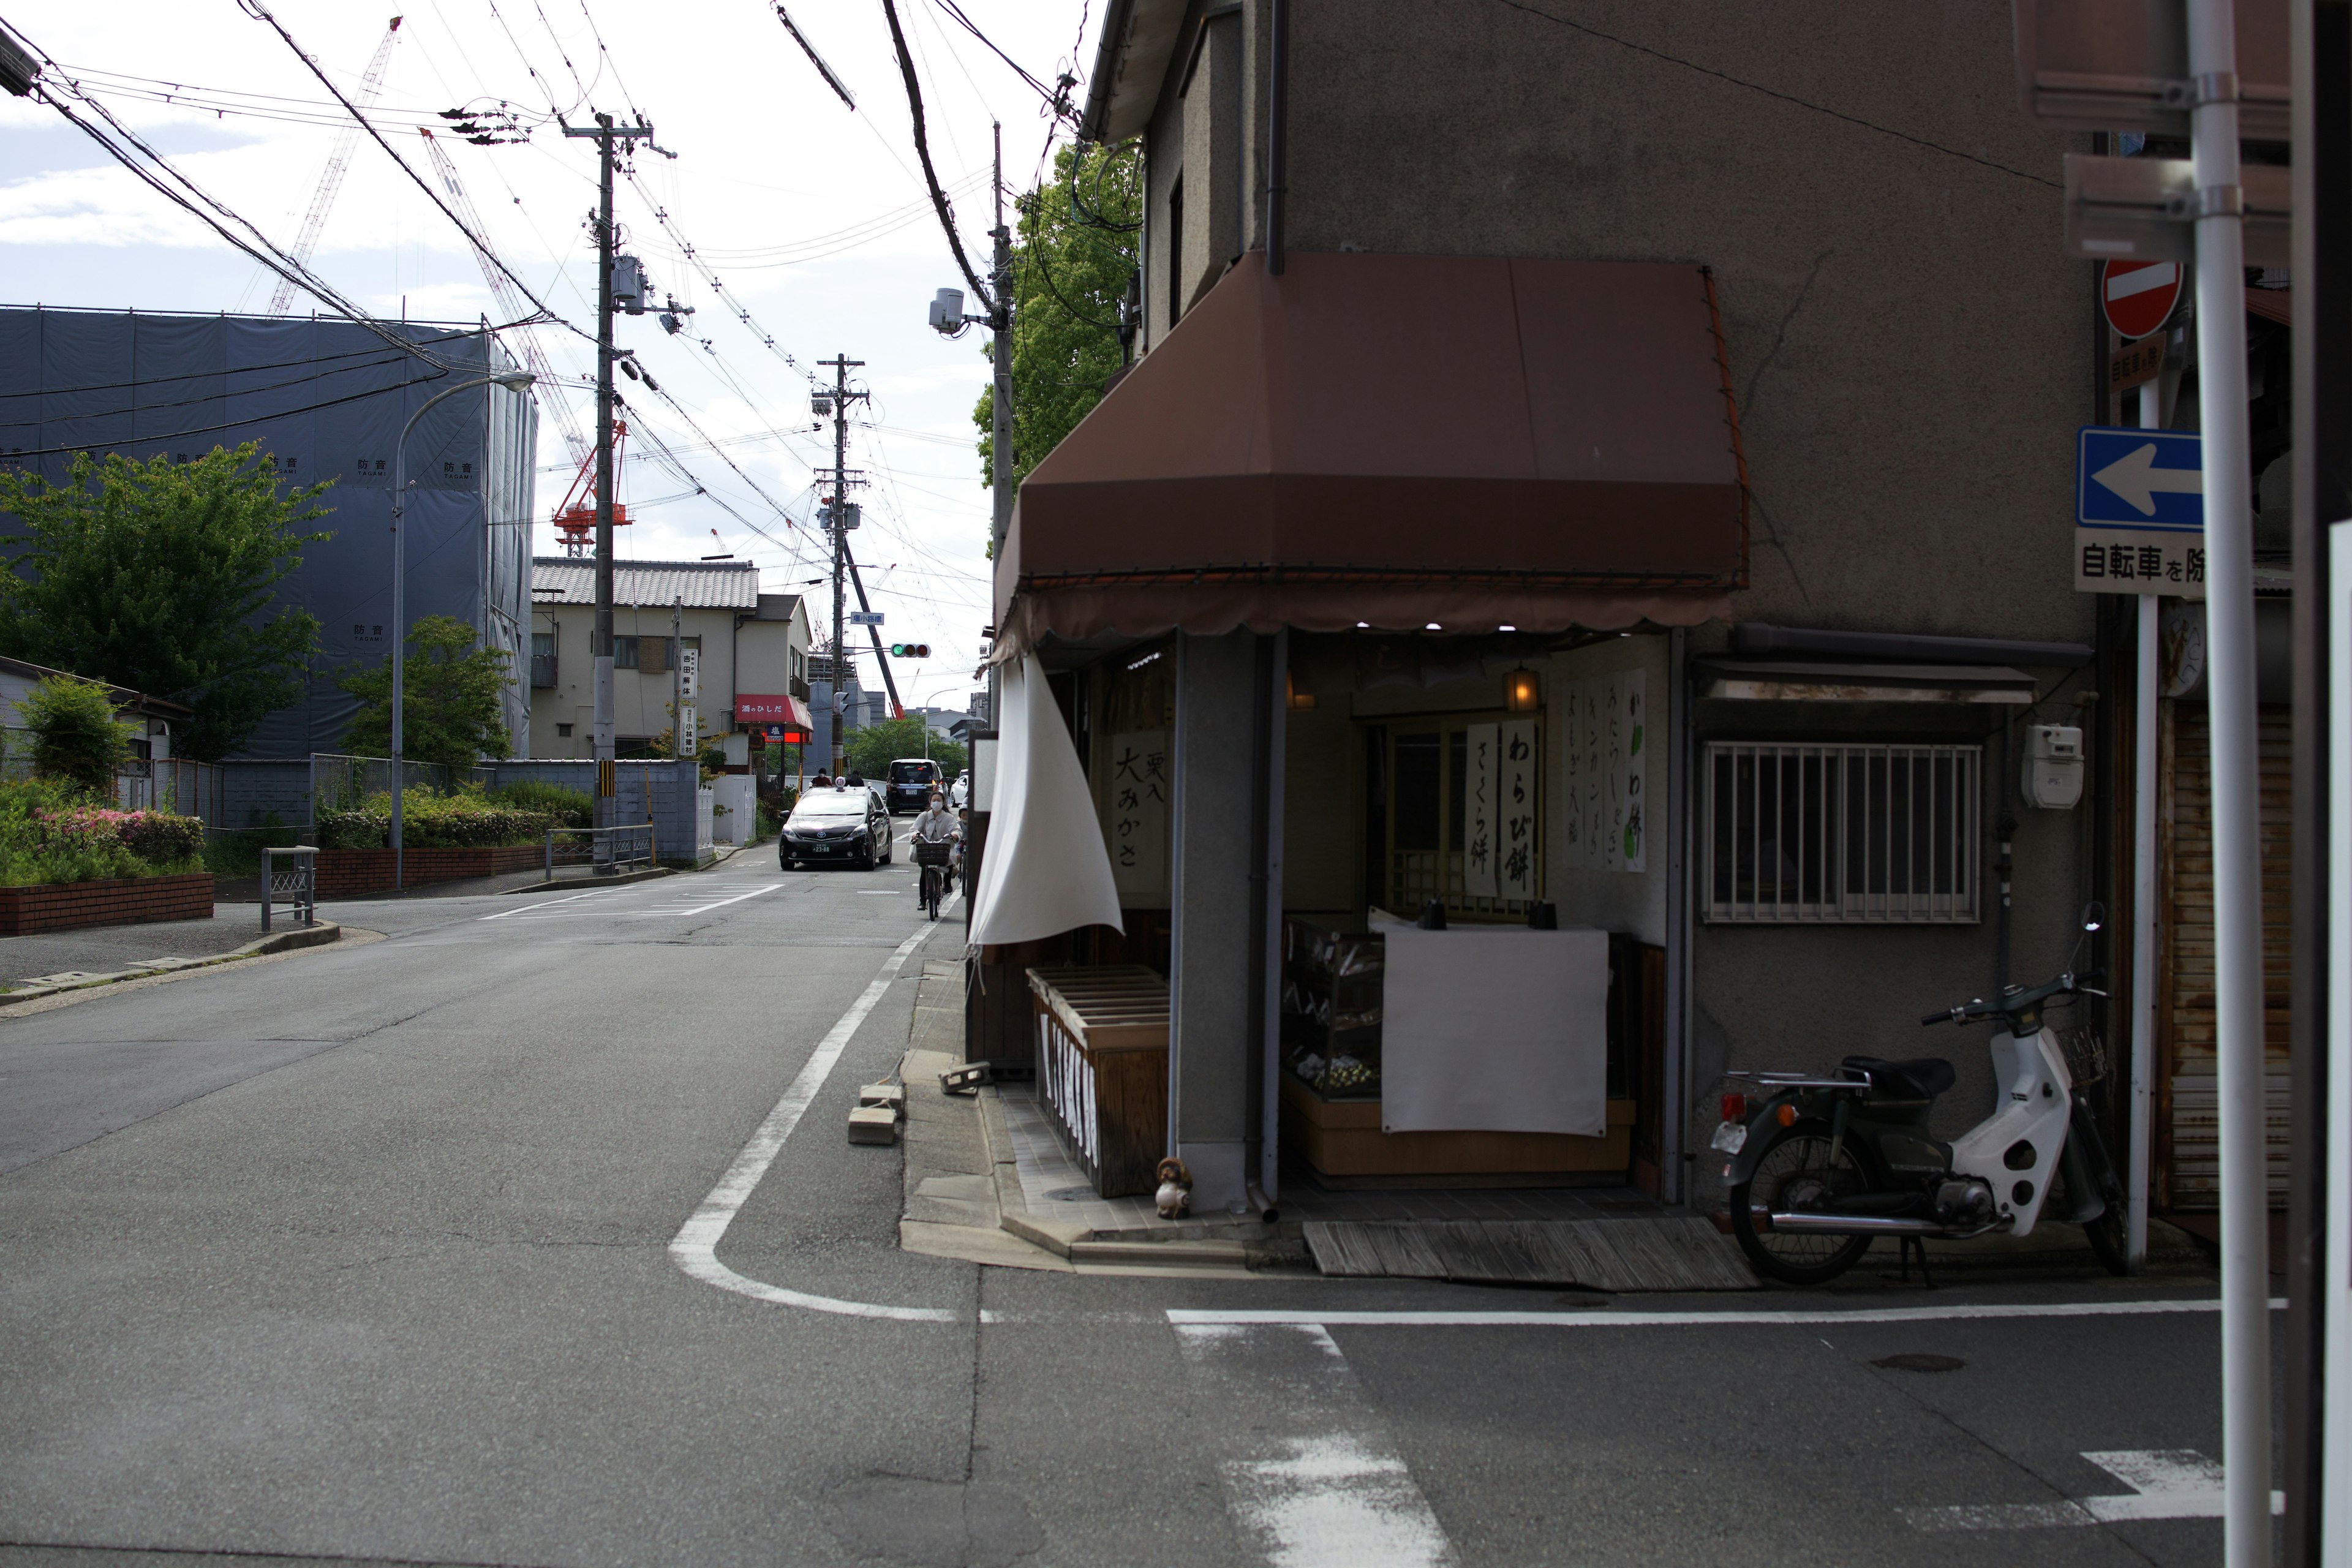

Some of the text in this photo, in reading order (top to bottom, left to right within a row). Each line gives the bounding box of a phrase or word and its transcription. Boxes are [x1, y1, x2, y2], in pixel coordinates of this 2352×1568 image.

[358, 459, 386, 470] 防音
[444, 462, 472, 473] 防音
[853, 614, 882, 623] 塩小路橋
[354, 624, 383, 635] 防音
[742, 704, 782, 713] 酒のひしだ
[771, 726, 780, 735] 塩
[1115, 747, 1145, 866] 大みかさ
[1470, 742, 1488, 875] さくら餅
[1505, 732, 1532, 892] わらび餅
